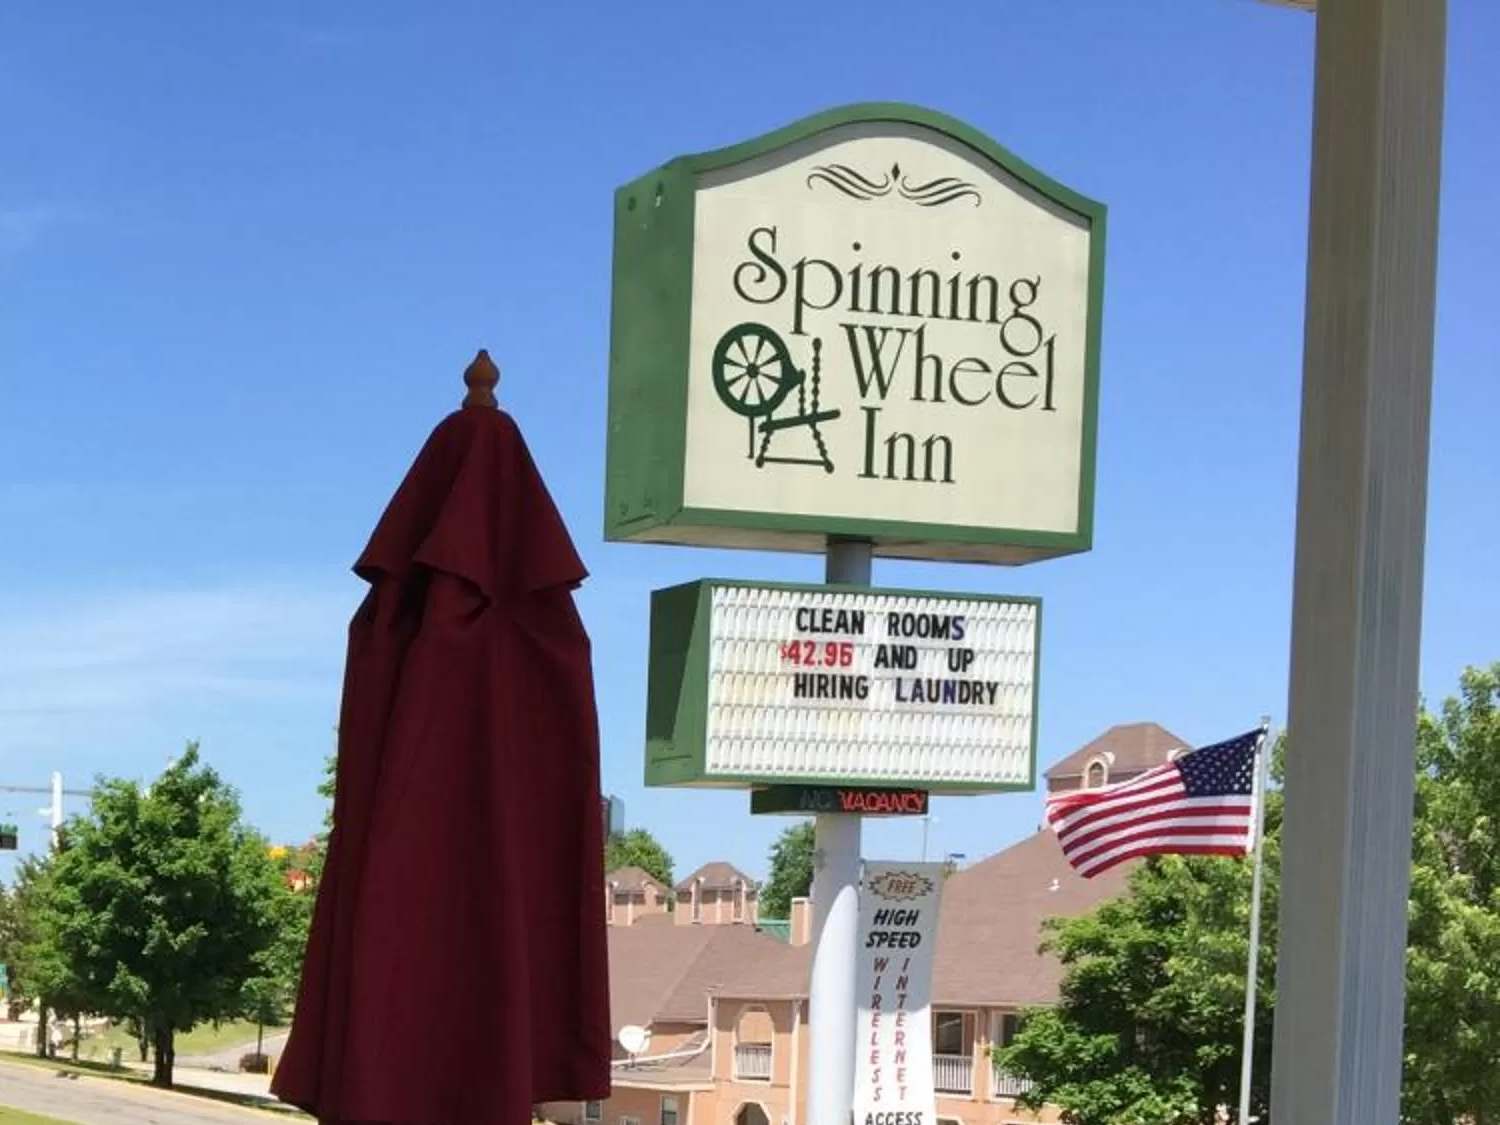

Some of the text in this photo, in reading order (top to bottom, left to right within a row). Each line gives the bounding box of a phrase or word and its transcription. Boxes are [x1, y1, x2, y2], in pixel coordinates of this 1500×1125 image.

[733, 226, 1043, 357] Spinning
[839, 323, 1057, 411] Wheel
[856, 406, 956, 484] Inn
[795, 607, 966, 641] CLEAN ROOMS
[874, 644, 918, 669] AND
[948, 648, 975, 673] UP
[794, 673, 999, 705] HIRING LAUNDRY
[838, 789, 926, 812] VACANCY
[873, 908, 920, 927] HIGH
[865, 931, 921, 949] SPEED
[870, 957, 888, 1102] WIRELESS
[895, 957, 910, 1101] INTERNET
